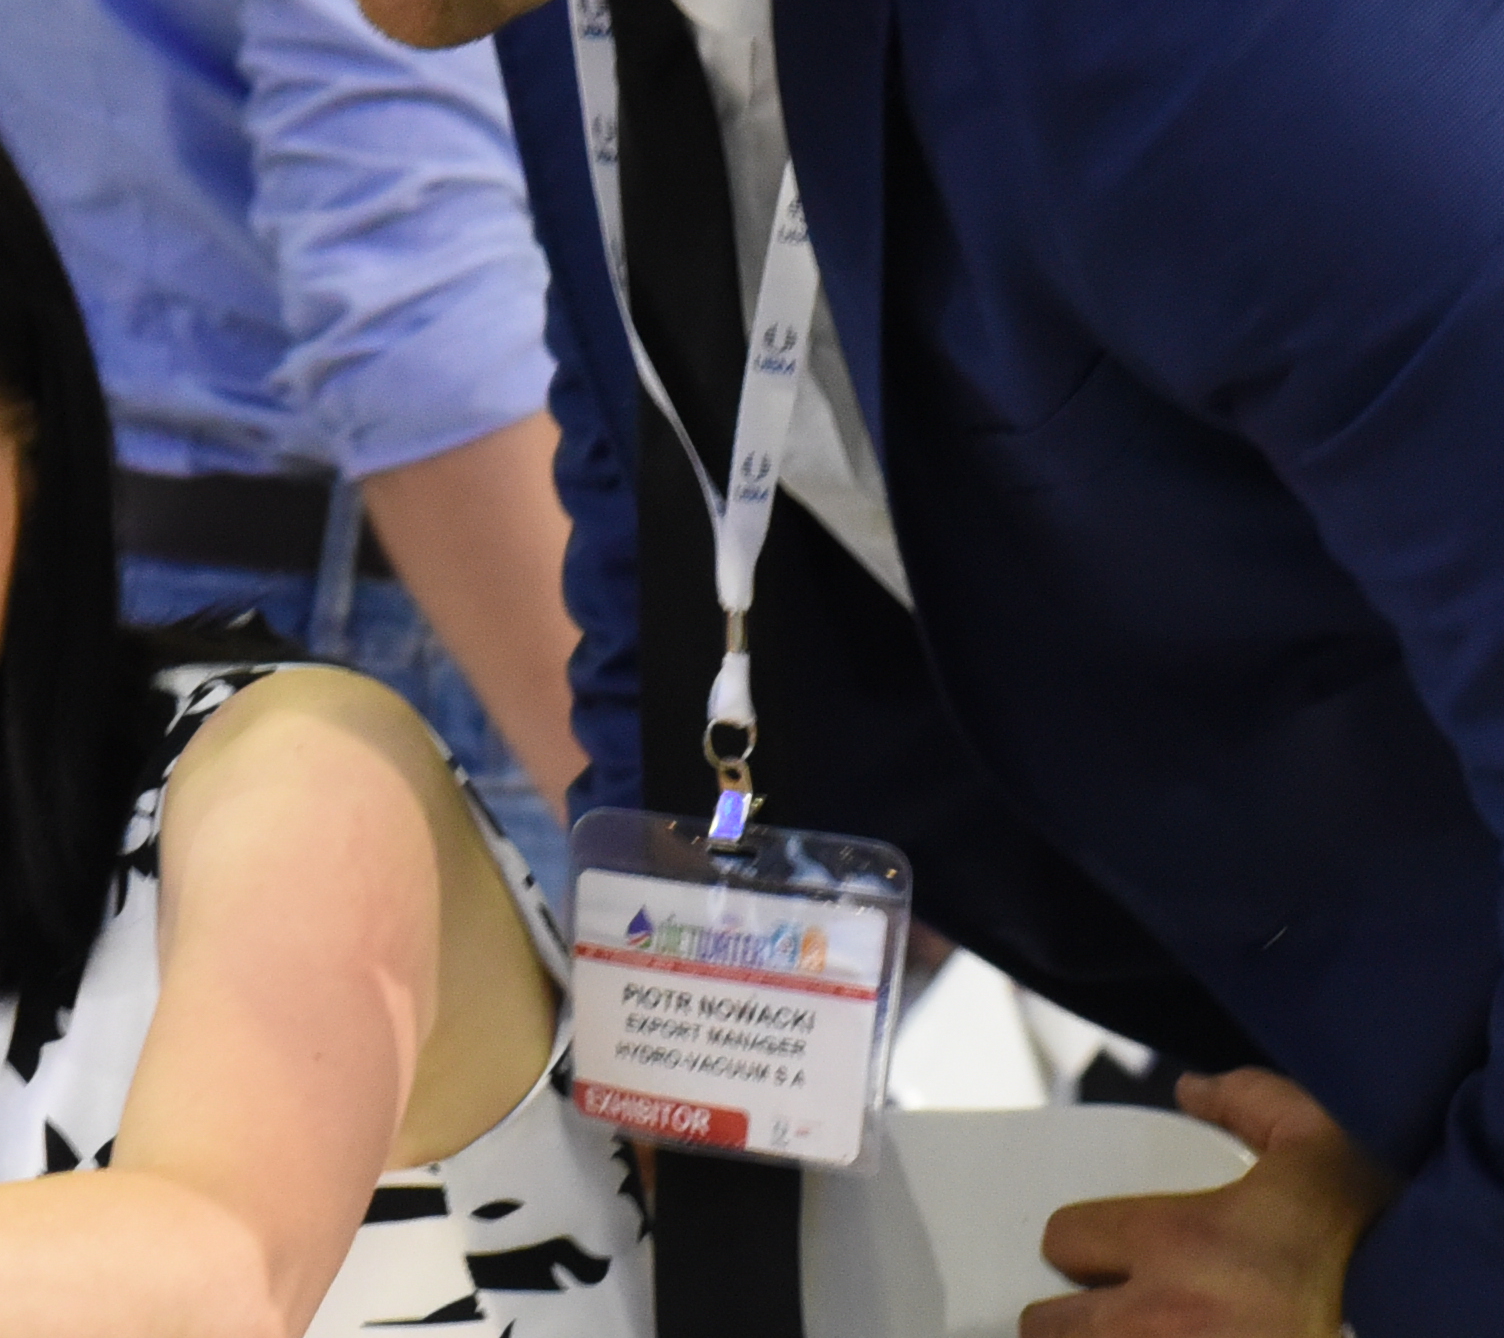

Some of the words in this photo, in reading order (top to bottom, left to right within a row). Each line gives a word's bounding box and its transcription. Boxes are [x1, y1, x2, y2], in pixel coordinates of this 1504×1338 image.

[621, 982, 692, 1014] PIOTR
[696, 994, 817, 1034] NOWACKI
[623, 1015, 700, 1043] EXPORT
[706, 1024, 808, 1056] MANAGER
[583, 1087, 713, 1137] EXHIBITOR
